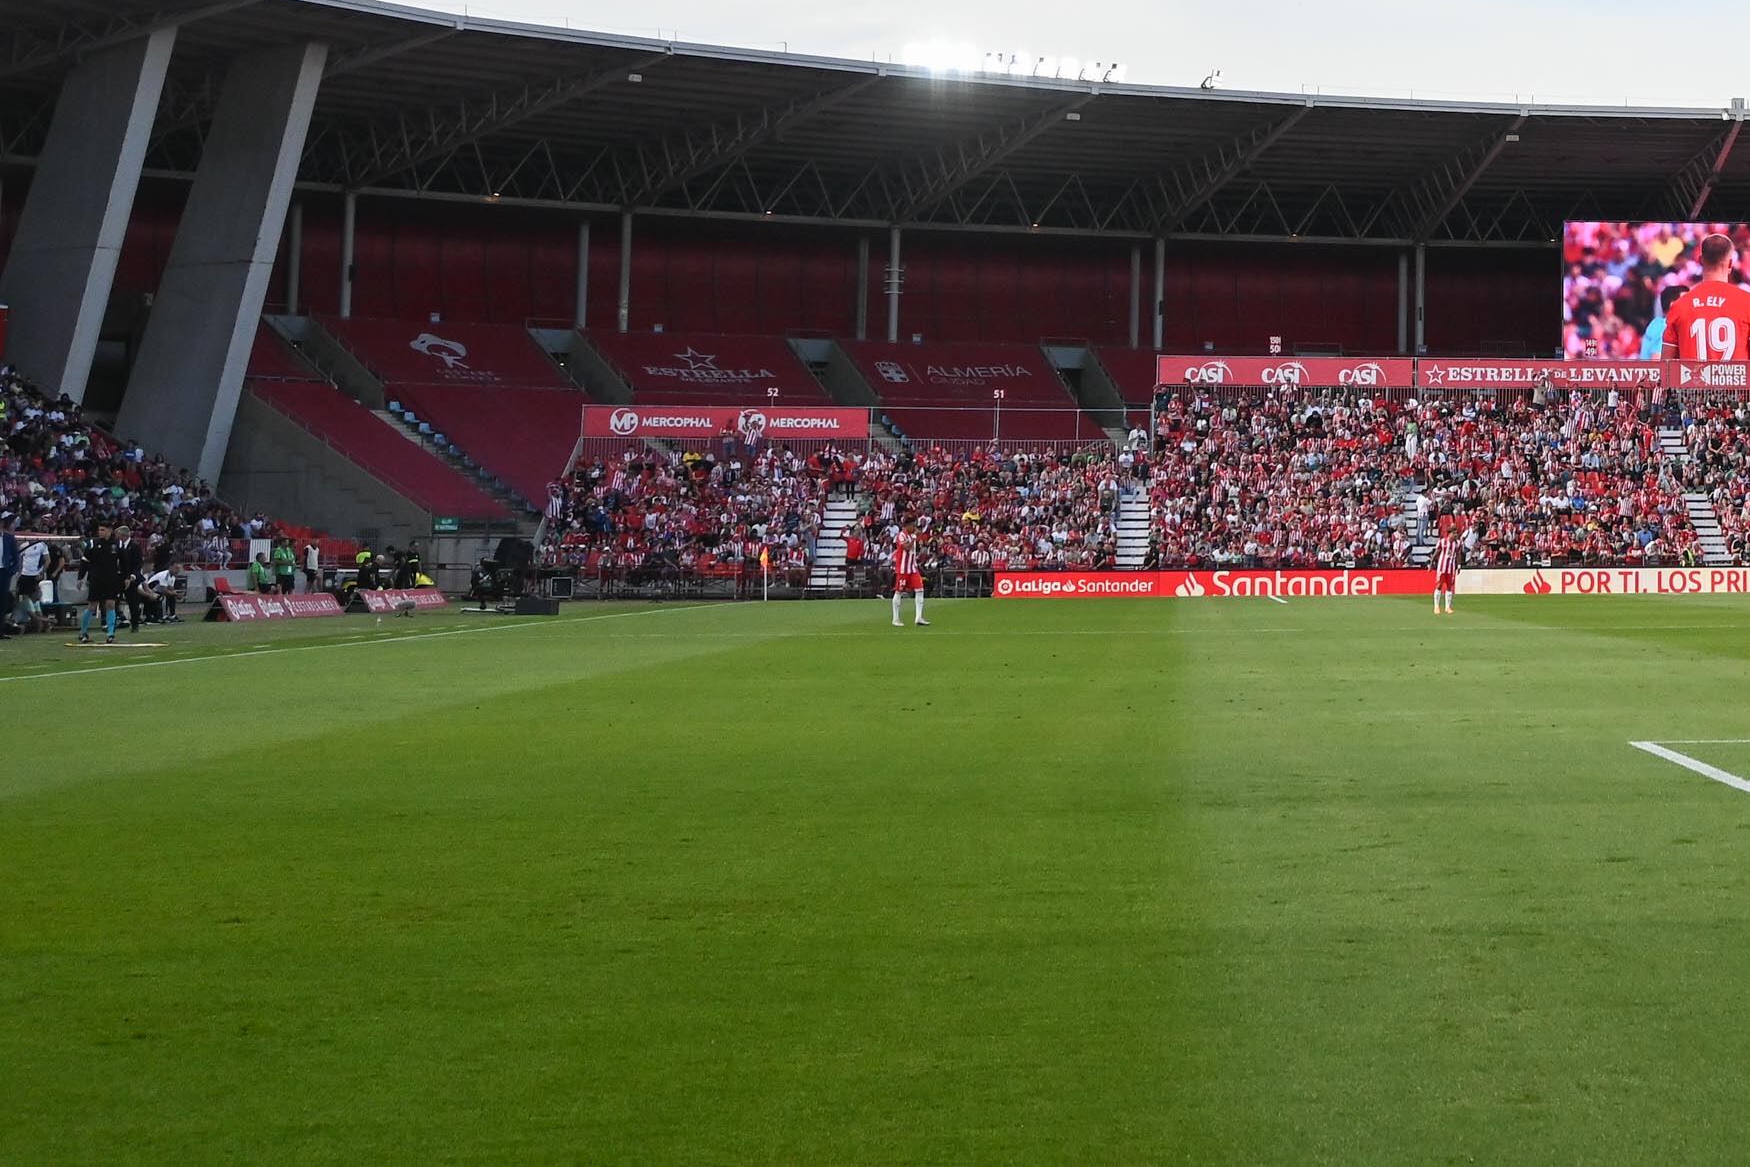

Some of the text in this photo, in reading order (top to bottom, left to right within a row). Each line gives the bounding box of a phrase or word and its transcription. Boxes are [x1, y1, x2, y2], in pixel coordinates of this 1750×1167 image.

[1692, 296, 1726, 308] R. ELY
[1690, 317, 1736, 361] 19
[641, 367, 776, 378] ESTRELLA
[927, 364, 1032, 377] ALMERÍA
[1184, 367, 1224, 384] CASI
[1261, 367, 1300, 384] CASI
[1554, 370, 1567, 379] DE
[1568, 368, 1660, 383] LEVANTE
[1711, 364, 1746, 375] POWER
[1338, 368, 1377, 385] CASI
[1711, 375, 1746, 386] HORSE
[767, 387, 779, 396] 52
[993, 390, 1005, 399] 51
[642, 416, 713, 428] MERCOPHAL
[769, 417, 840, 429] MERCOPHAL
[1015, 578, 1154, 594] LaLiga Santander
[1212, 570, 1384, 596] Santander
[1560, 571, 1612, 593] POR
[1656, 571, 1701, 593] LOS
